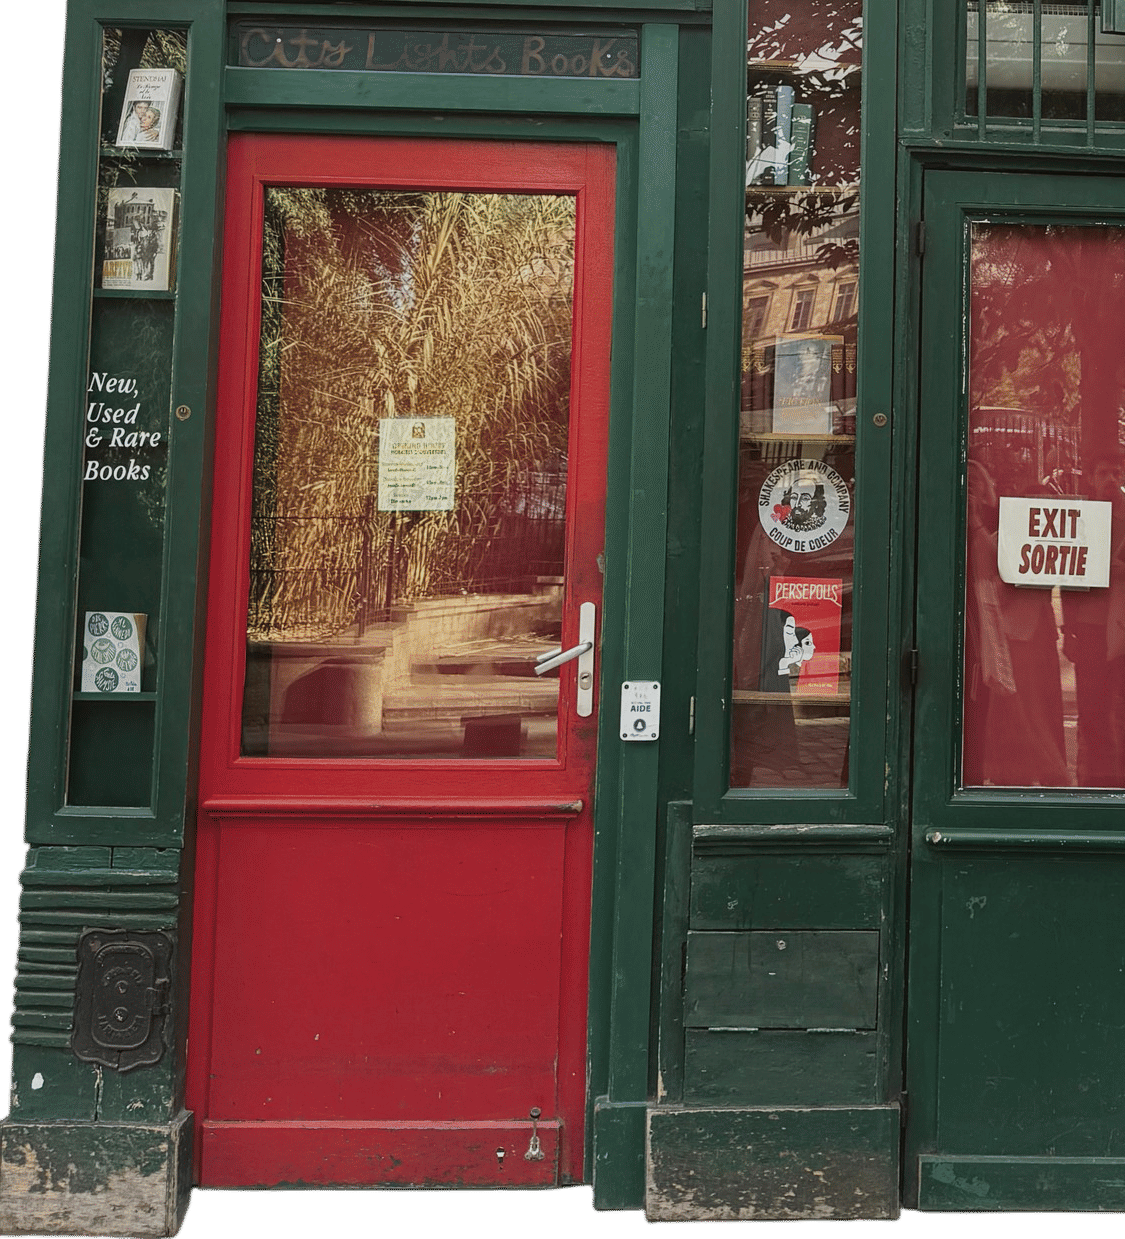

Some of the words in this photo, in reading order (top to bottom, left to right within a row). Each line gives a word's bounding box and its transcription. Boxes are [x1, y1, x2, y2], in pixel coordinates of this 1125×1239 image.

[241, 28, 353, 68] City
[365, 32, 507, 74] Lights
[87, 371, 139, 399] New,
[86, 402, 141, 425] Used
[85, 426, 103, 448] &
[108, 427, 161, 448] Rare
[84, 459, 151, 481] Books
[759, 460, 805, 506] SHAKESPEARE
[808, 460, 828, 475] AND
[827, 470, 849, 514] COMPANY
[1029, 507, 1081, 538] EXIT
[769, 527, 793, 548] COUP
[794, 540, 805, 552] DE
[809, 528, 839, 551] COEUR
[1018, 543, 1088, 576] SORTIE
[775, 582, 838, 601] PERSEPOLIS
[630, 705, 651, 713] AIDE
